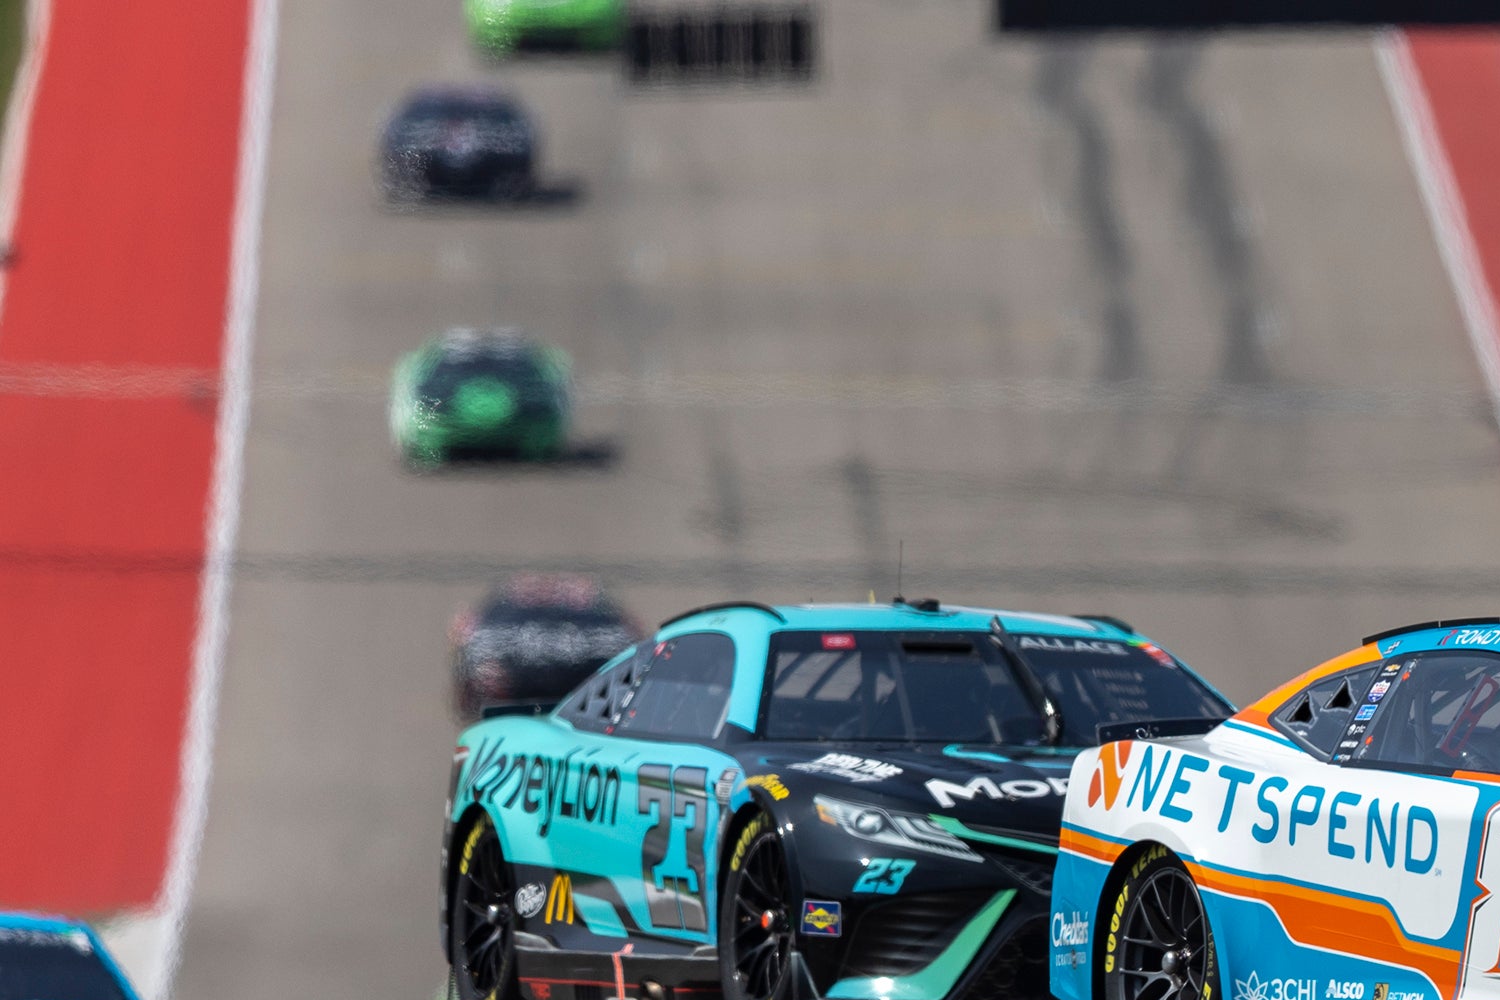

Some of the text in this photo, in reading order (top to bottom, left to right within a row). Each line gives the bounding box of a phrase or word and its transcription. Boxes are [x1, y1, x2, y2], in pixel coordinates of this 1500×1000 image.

[1016, 636, 1130, 655] ALLACE
[1126, 744, 1439, 875] NETSPEND
[852, 857, 917, 895] 23
[1325, 978, 1365, 999] ALSCO
